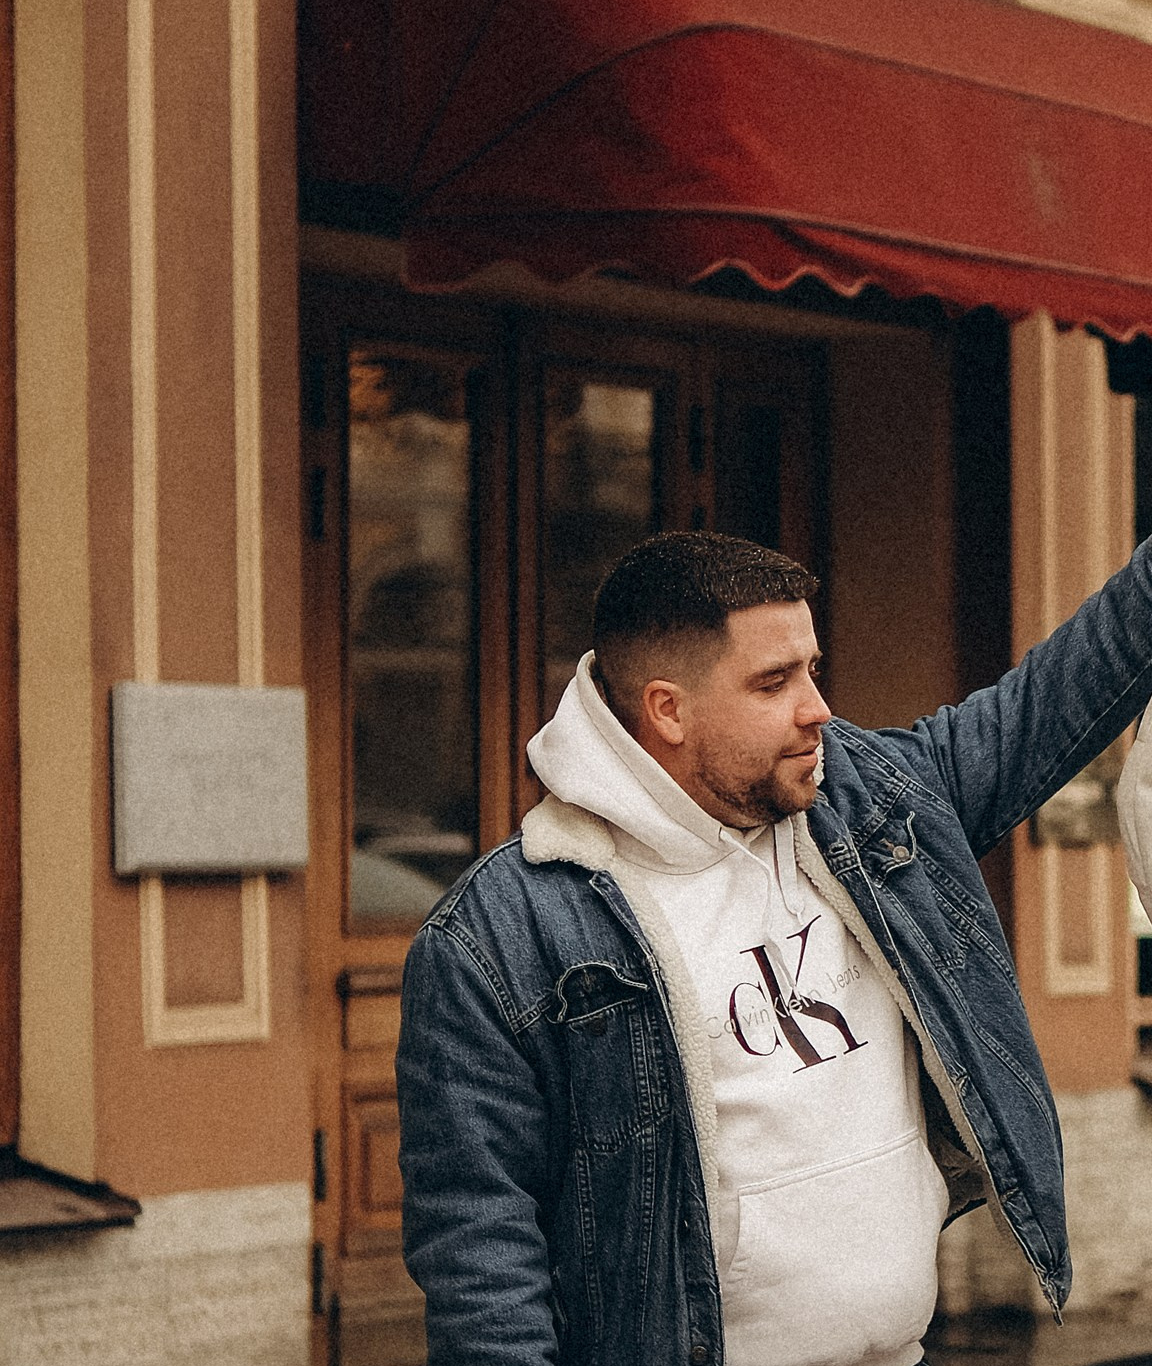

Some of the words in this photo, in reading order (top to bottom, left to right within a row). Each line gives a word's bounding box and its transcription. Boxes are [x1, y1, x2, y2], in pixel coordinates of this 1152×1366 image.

[704, 1005, 771, 1039] Cavin
[773, 989, 822, 1018] Klein
[826, 965, 861, 994] Jeans
